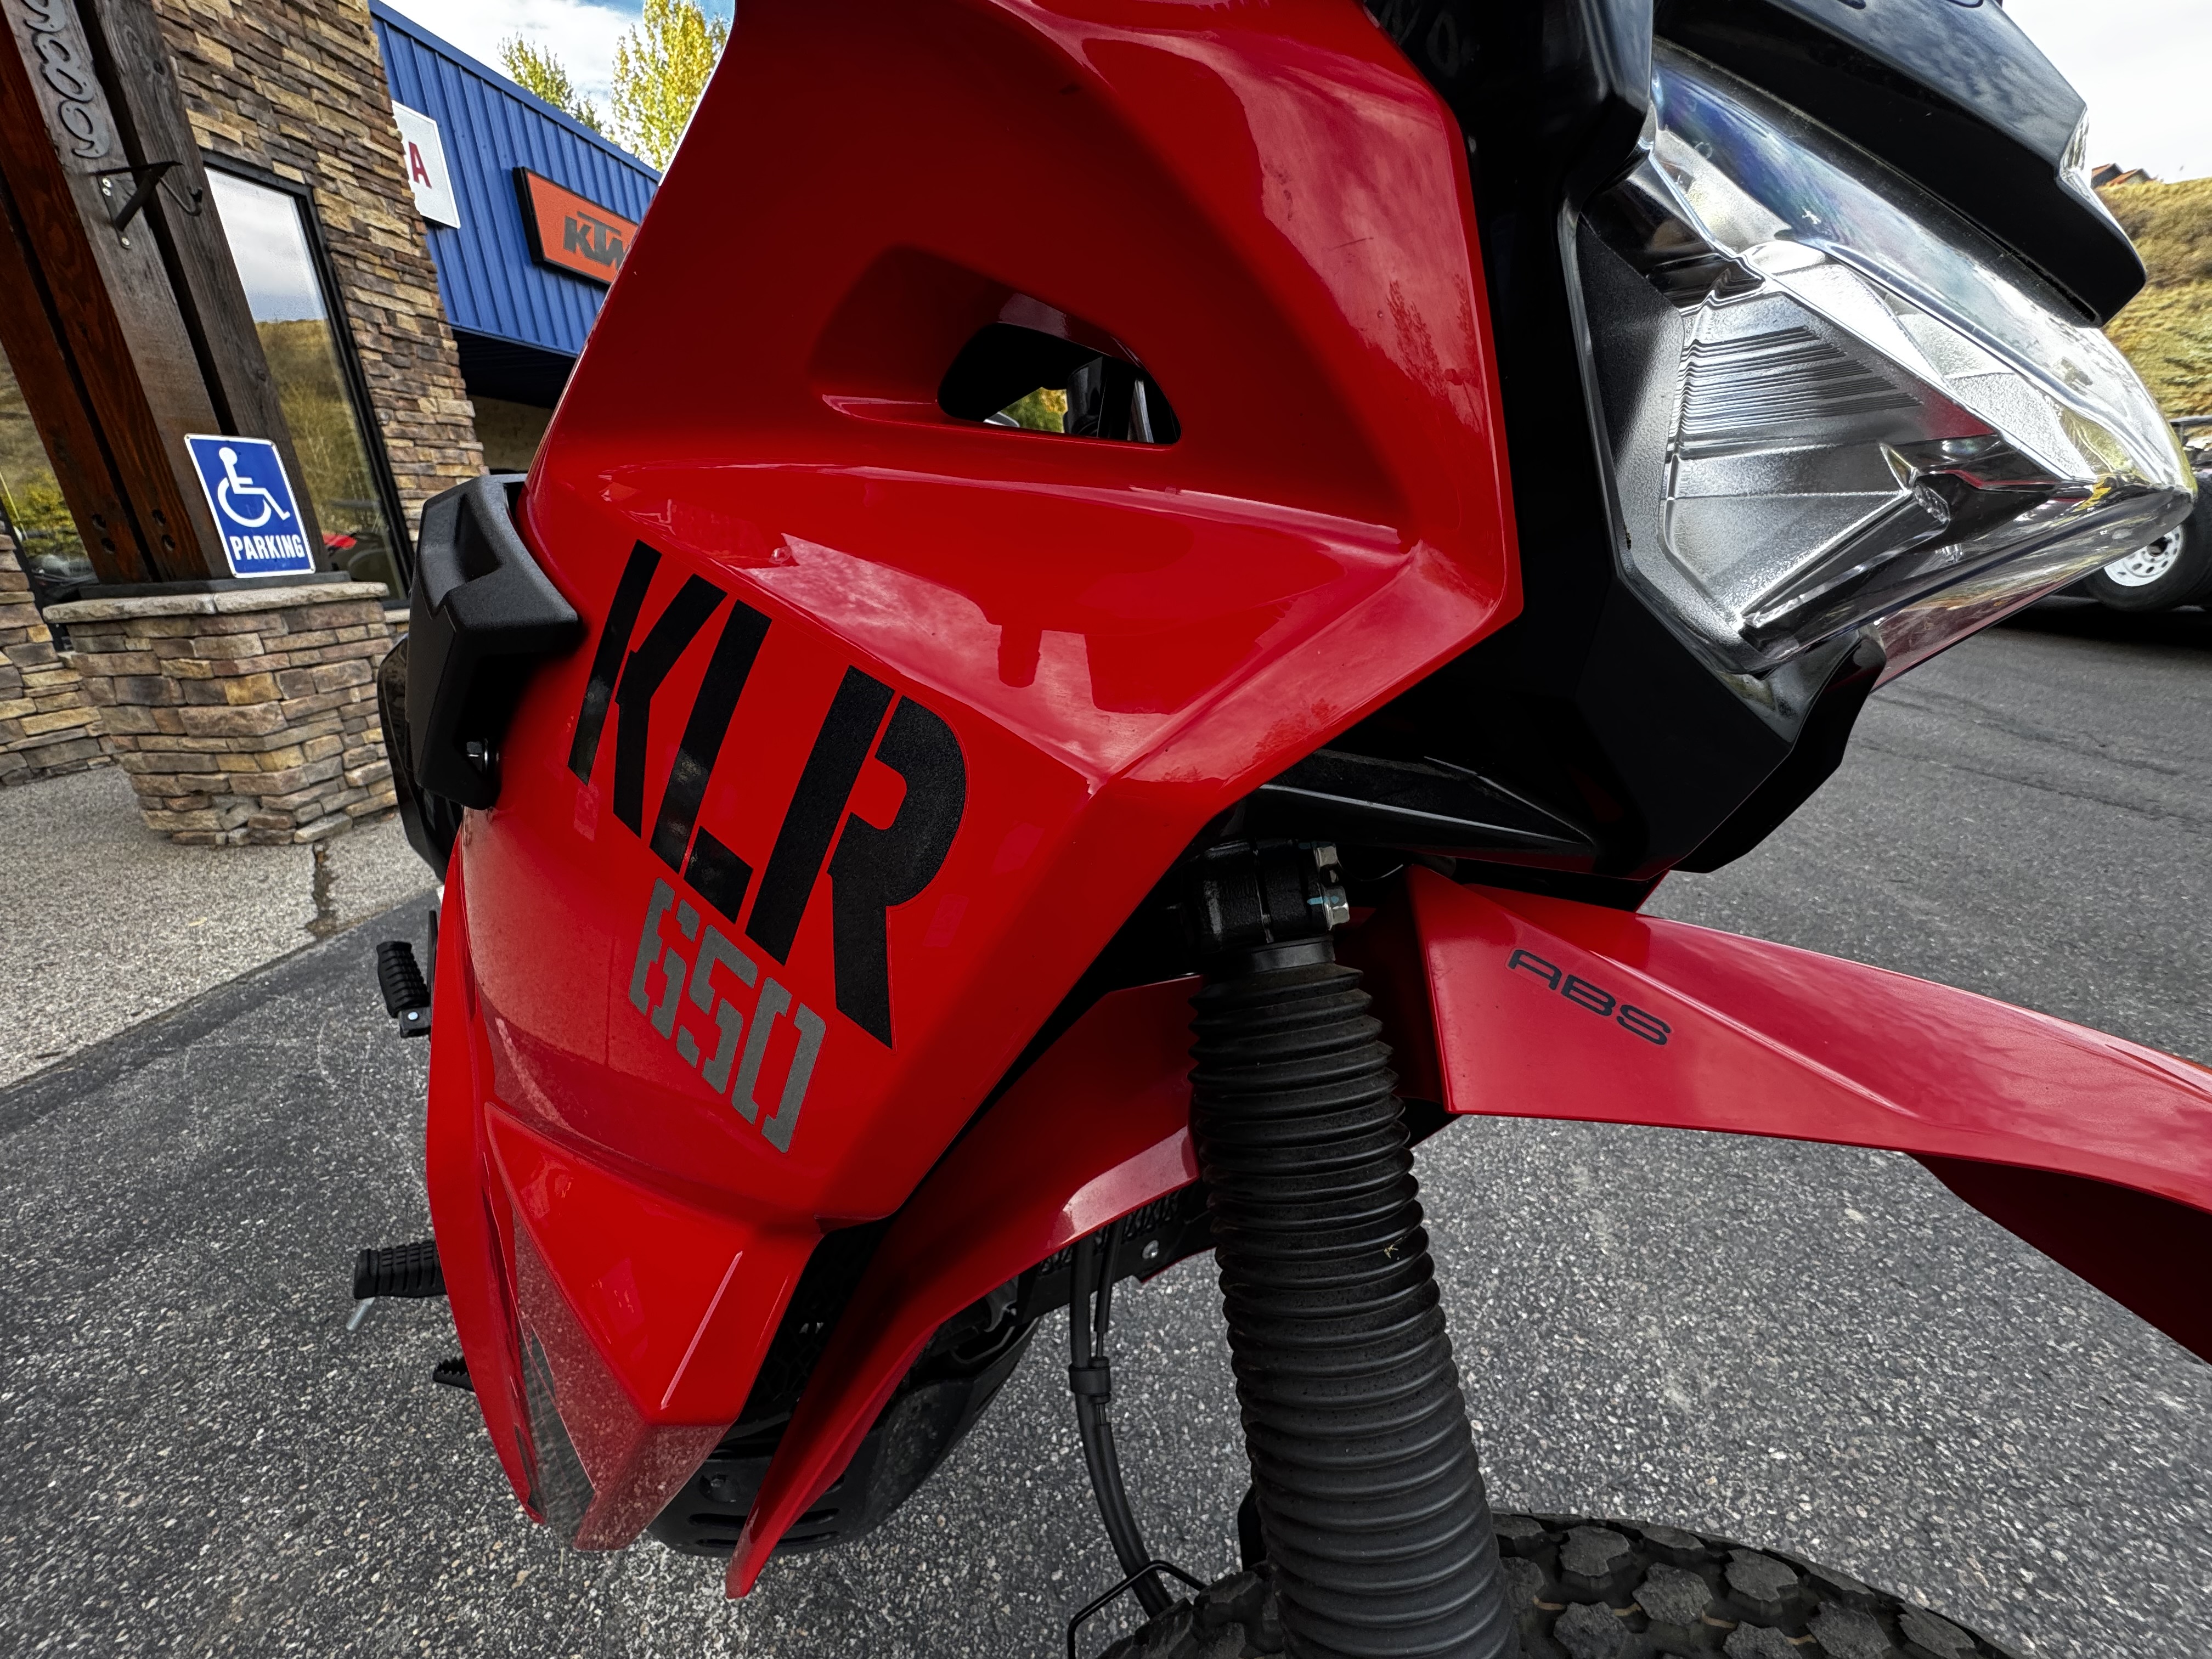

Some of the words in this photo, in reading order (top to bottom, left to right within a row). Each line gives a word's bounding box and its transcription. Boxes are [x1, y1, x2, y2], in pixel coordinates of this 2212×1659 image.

[230, 534, 305, 560] PARKING
[567, 540, 967, 1049] KLR
[629, 878, 826, 1153] 650
[1508, 949, 1671, 1045] ABS
